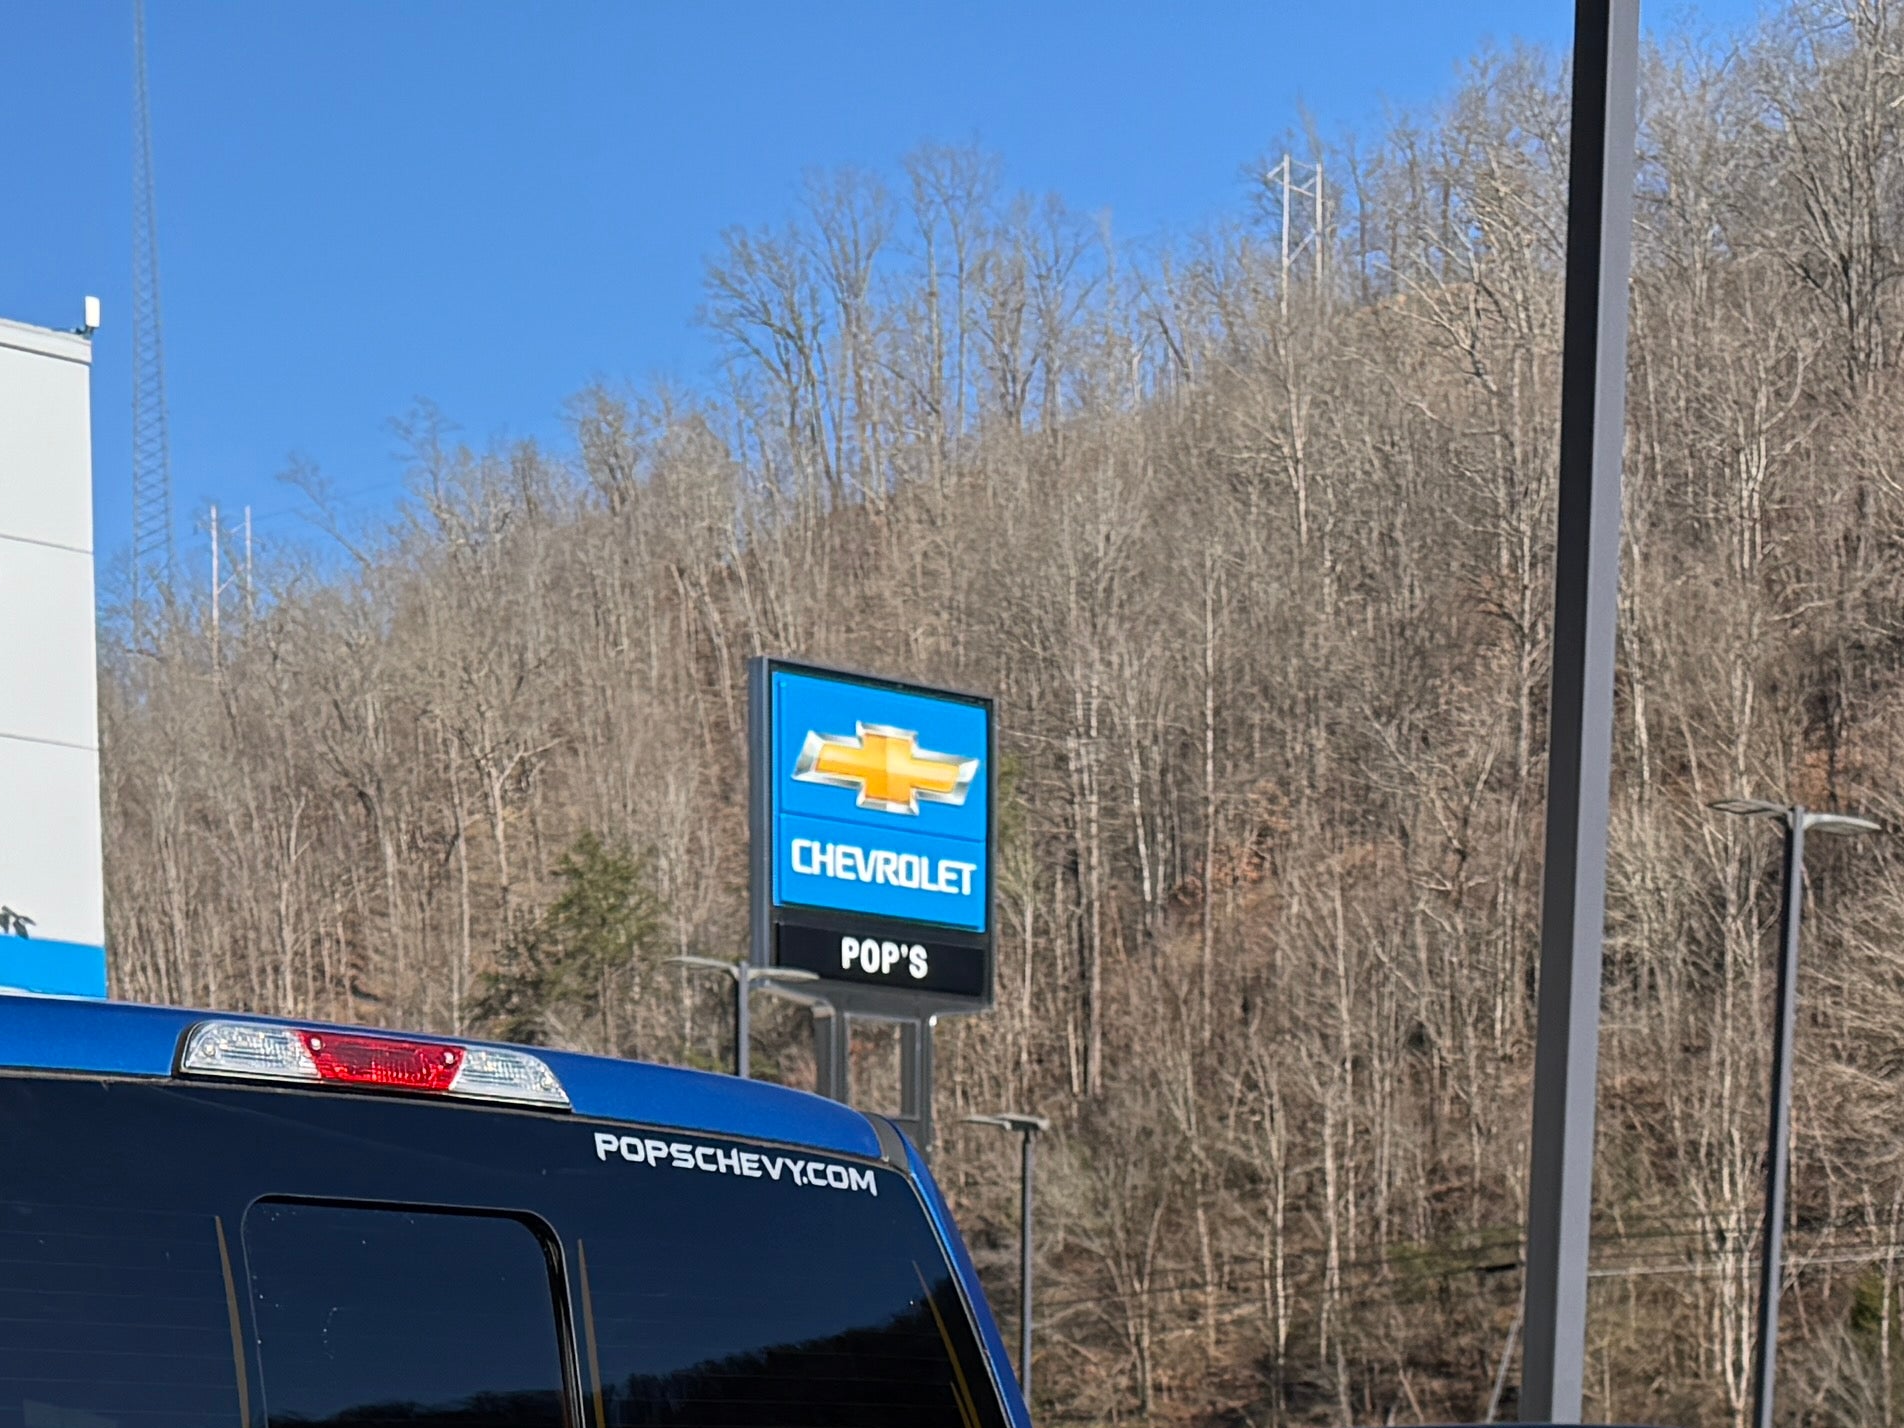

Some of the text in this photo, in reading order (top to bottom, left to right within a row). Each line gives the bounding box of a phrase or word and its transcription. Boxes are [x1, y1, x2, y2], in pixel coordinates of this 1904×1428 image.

[791, 838, 977, 896] CHEVROLET
[840, 936, 929, 980] POP'S
[594, 1132, 878, 1197] POPSCHEVY.COM
